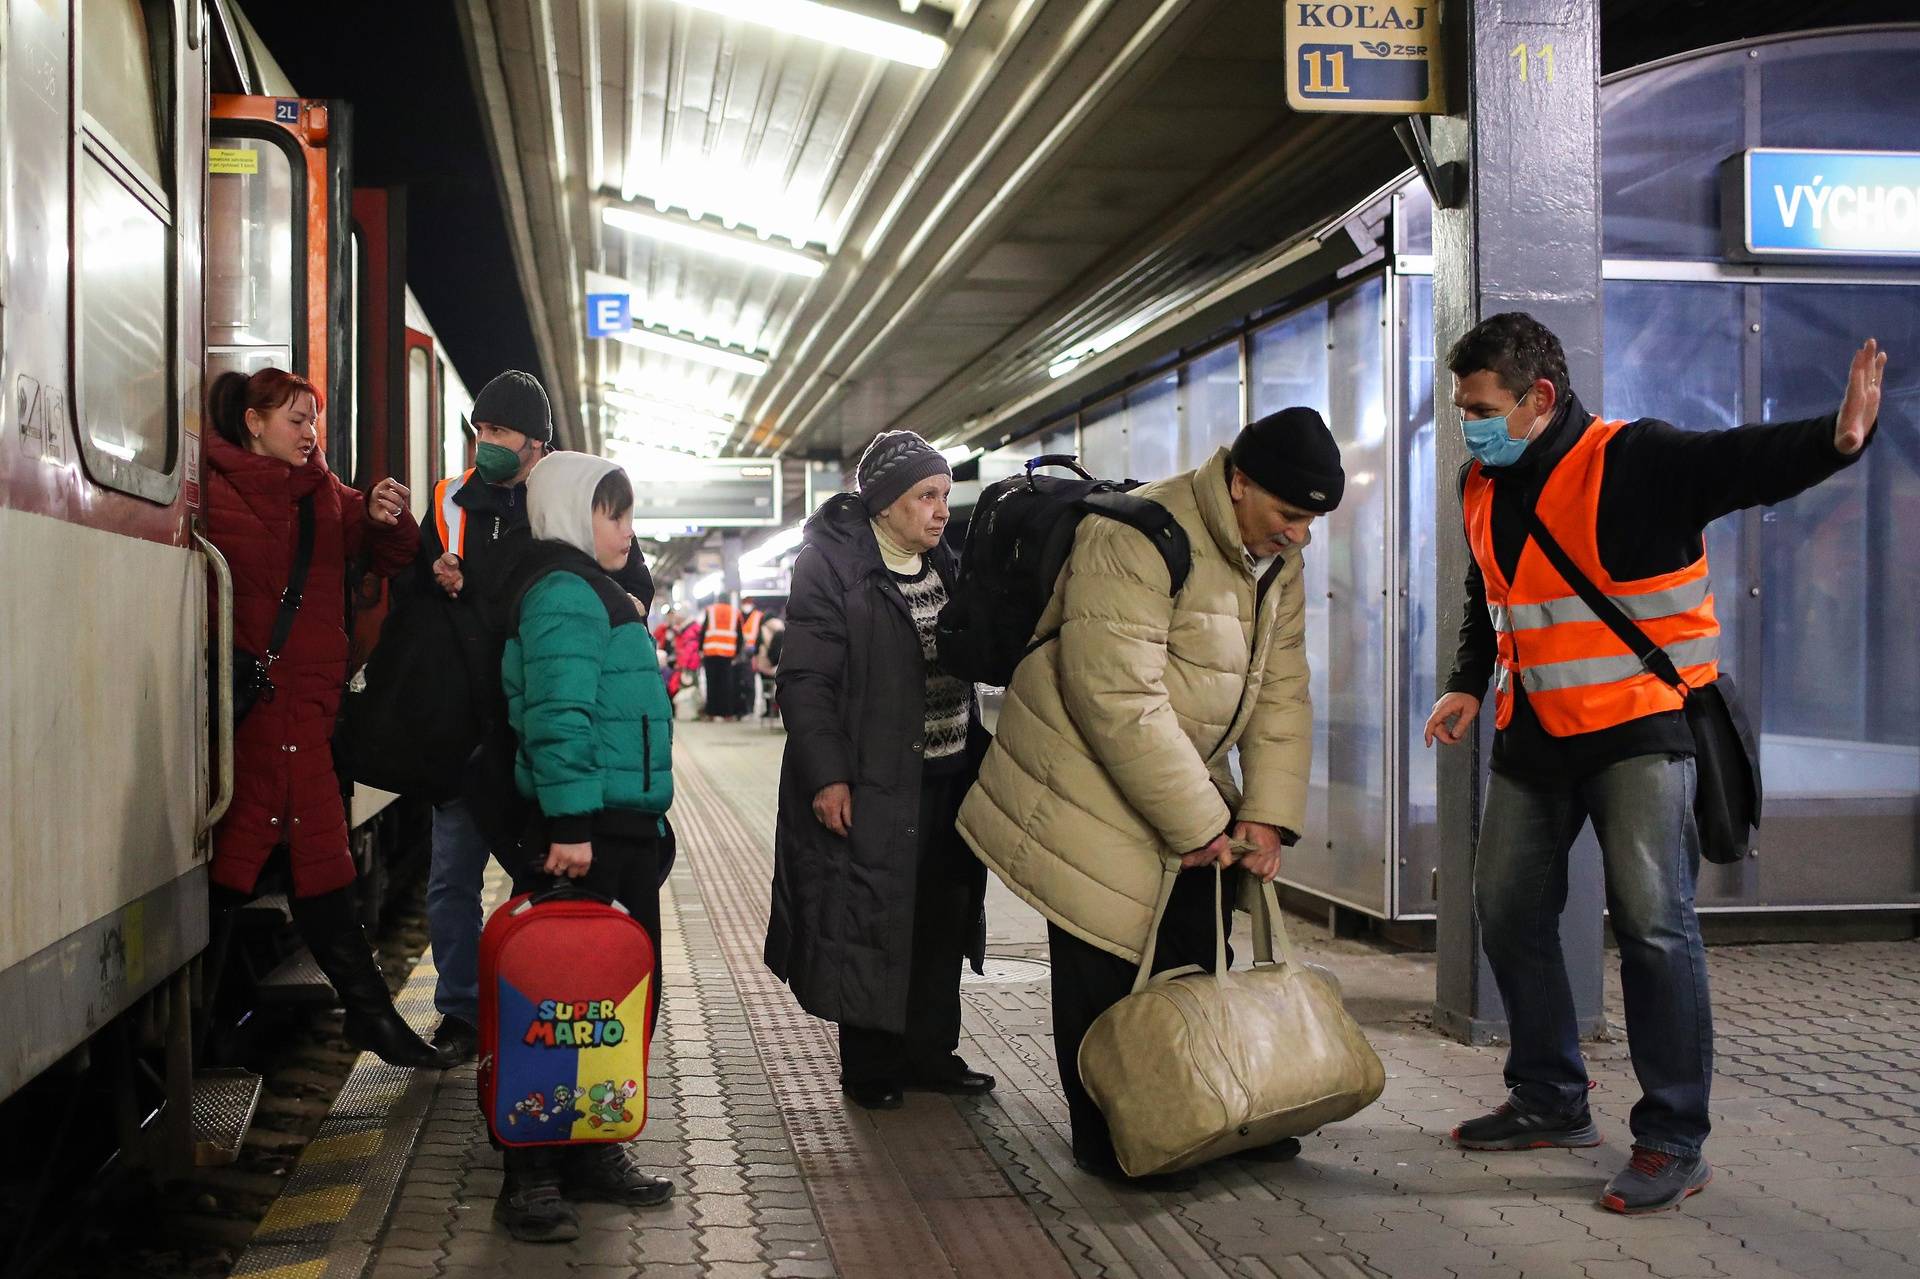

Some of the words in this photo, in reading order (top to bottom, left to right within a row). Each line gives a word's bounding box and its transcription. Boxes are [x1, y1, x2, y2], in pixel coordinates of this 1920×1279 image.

[1297, 4, 1427, 30] KOĽAJ
[1303, 50, 1350, 93] 11
[1509, 43, 1553, 83] 11
[277, 105, 297, 120] 2L
[1773, 175, 1920, 232] VÝCHO
[597, 300, 621, 331] E
[538, 999, 617, 1021] SUPER
[523, 1019, 625, 1048] MARIO
